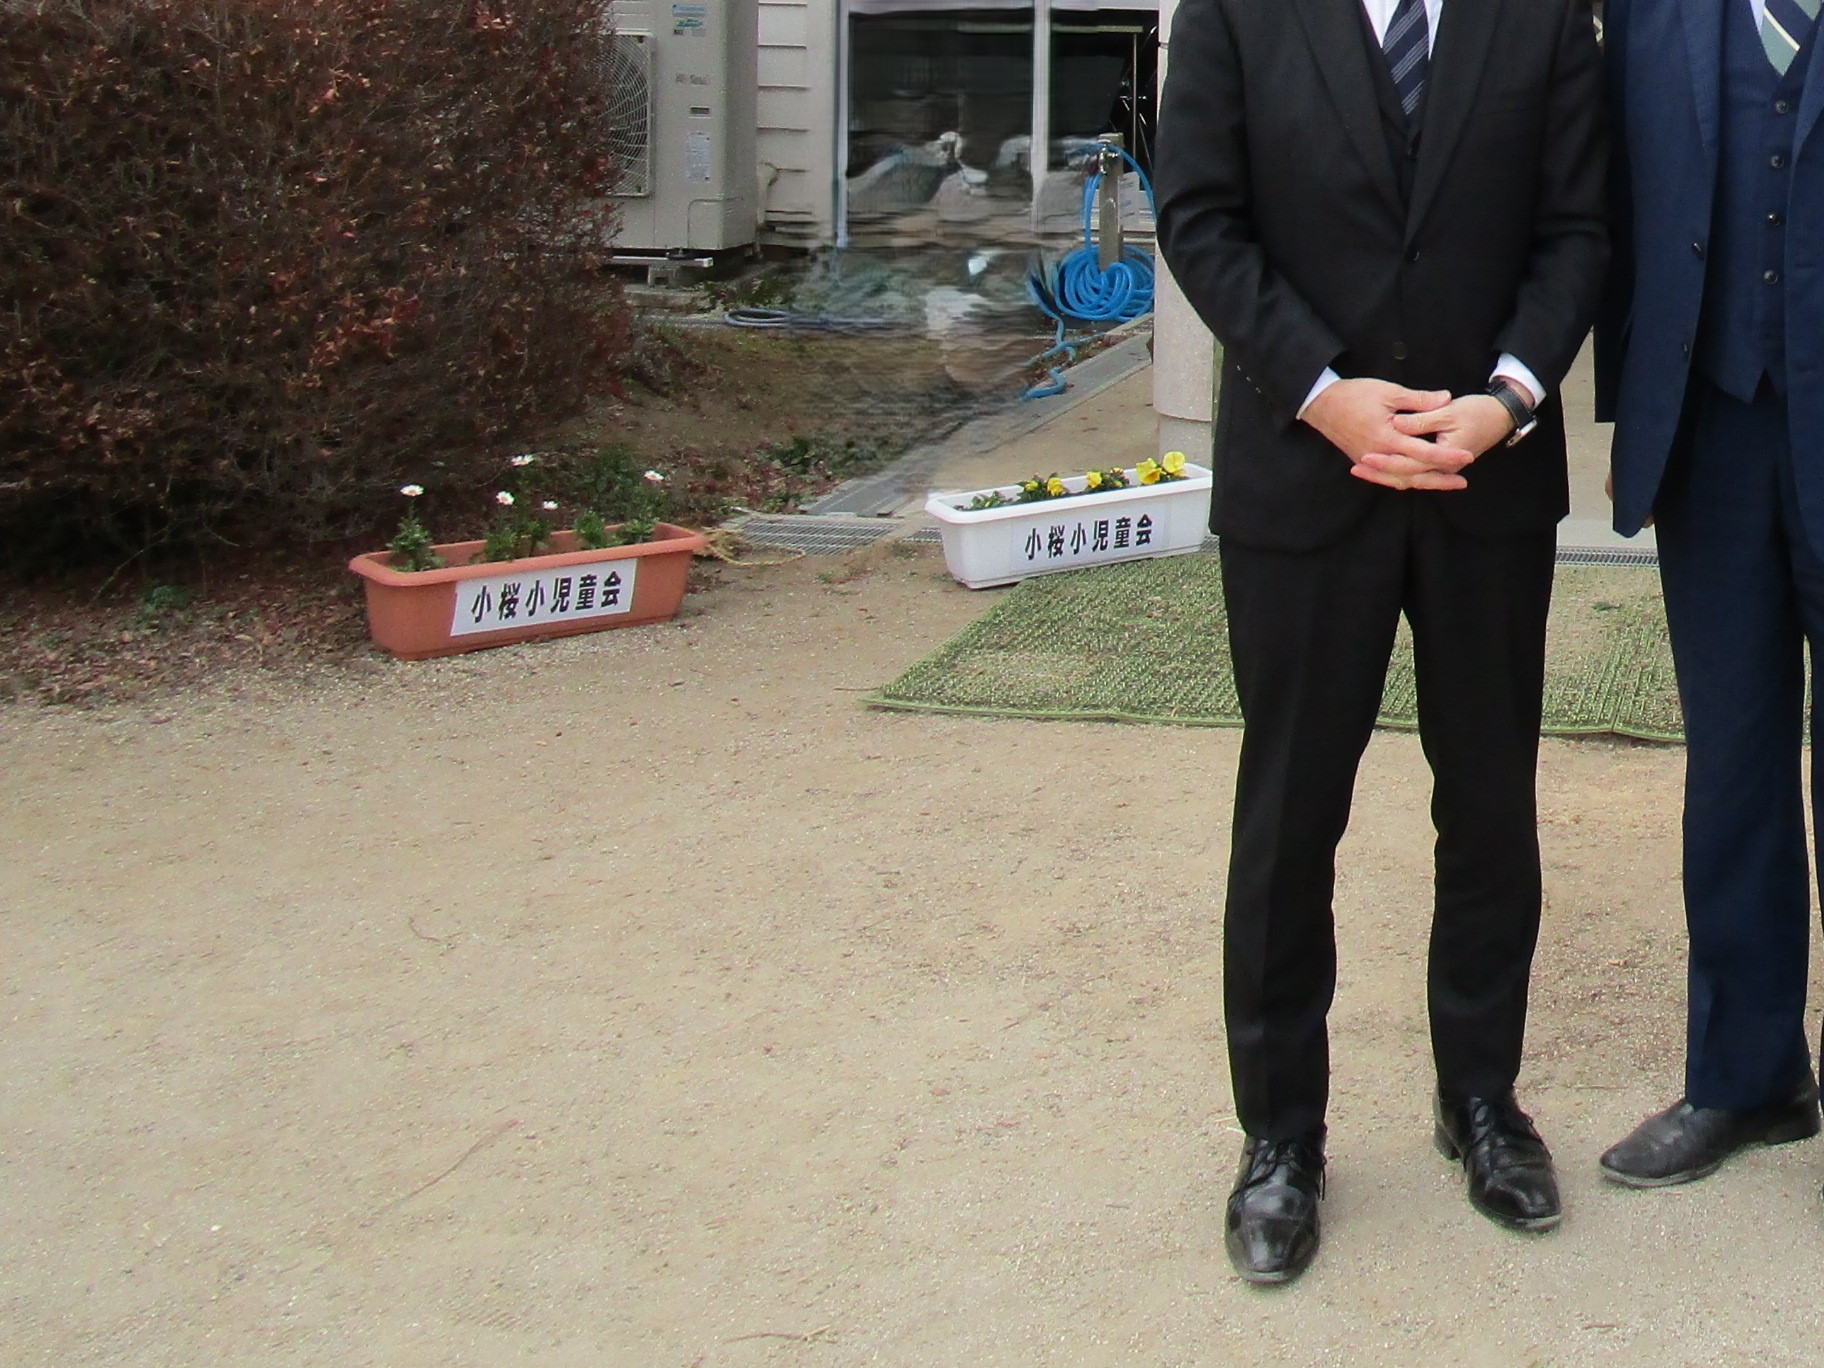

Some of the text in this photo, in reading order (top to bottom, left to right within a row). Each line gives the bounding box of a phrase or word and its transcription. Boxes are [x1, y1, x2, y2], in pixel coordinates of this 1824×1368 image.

[1025, 513, 1153, 560] 小桜小児童会
[471, 570, 622, 623] 小桜小児童会
